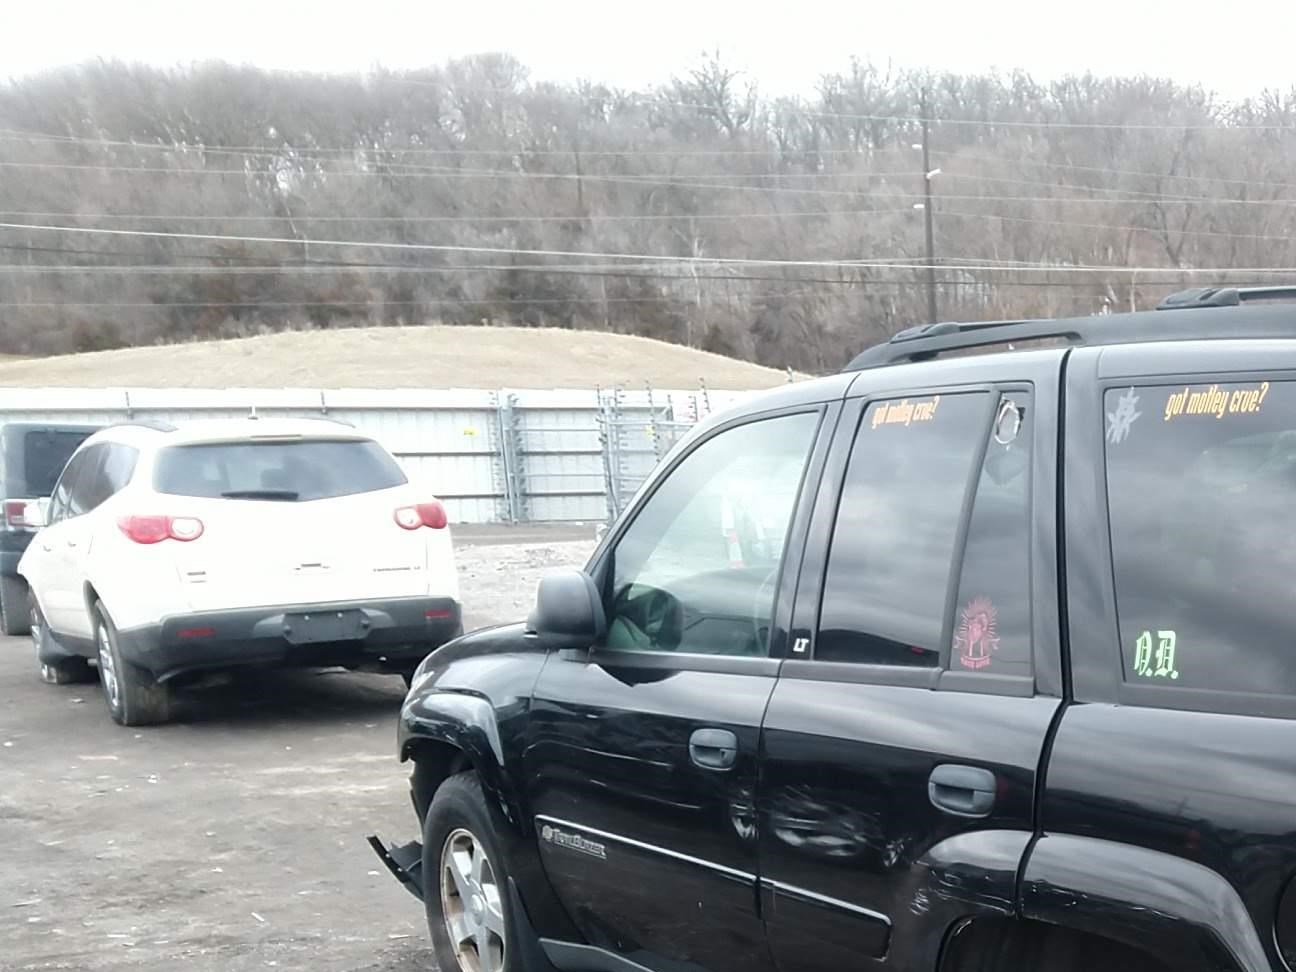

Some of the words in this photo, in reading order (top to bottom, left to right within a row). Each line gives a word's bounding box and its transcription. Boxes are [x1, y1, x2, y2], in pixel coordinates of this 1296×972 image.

[1164, 387, 1190, 421] got
[1186, 384, 1230, 419] motley
[1229, 381, 1270, 413] crue?
[793, 637, 810, 653] LT
